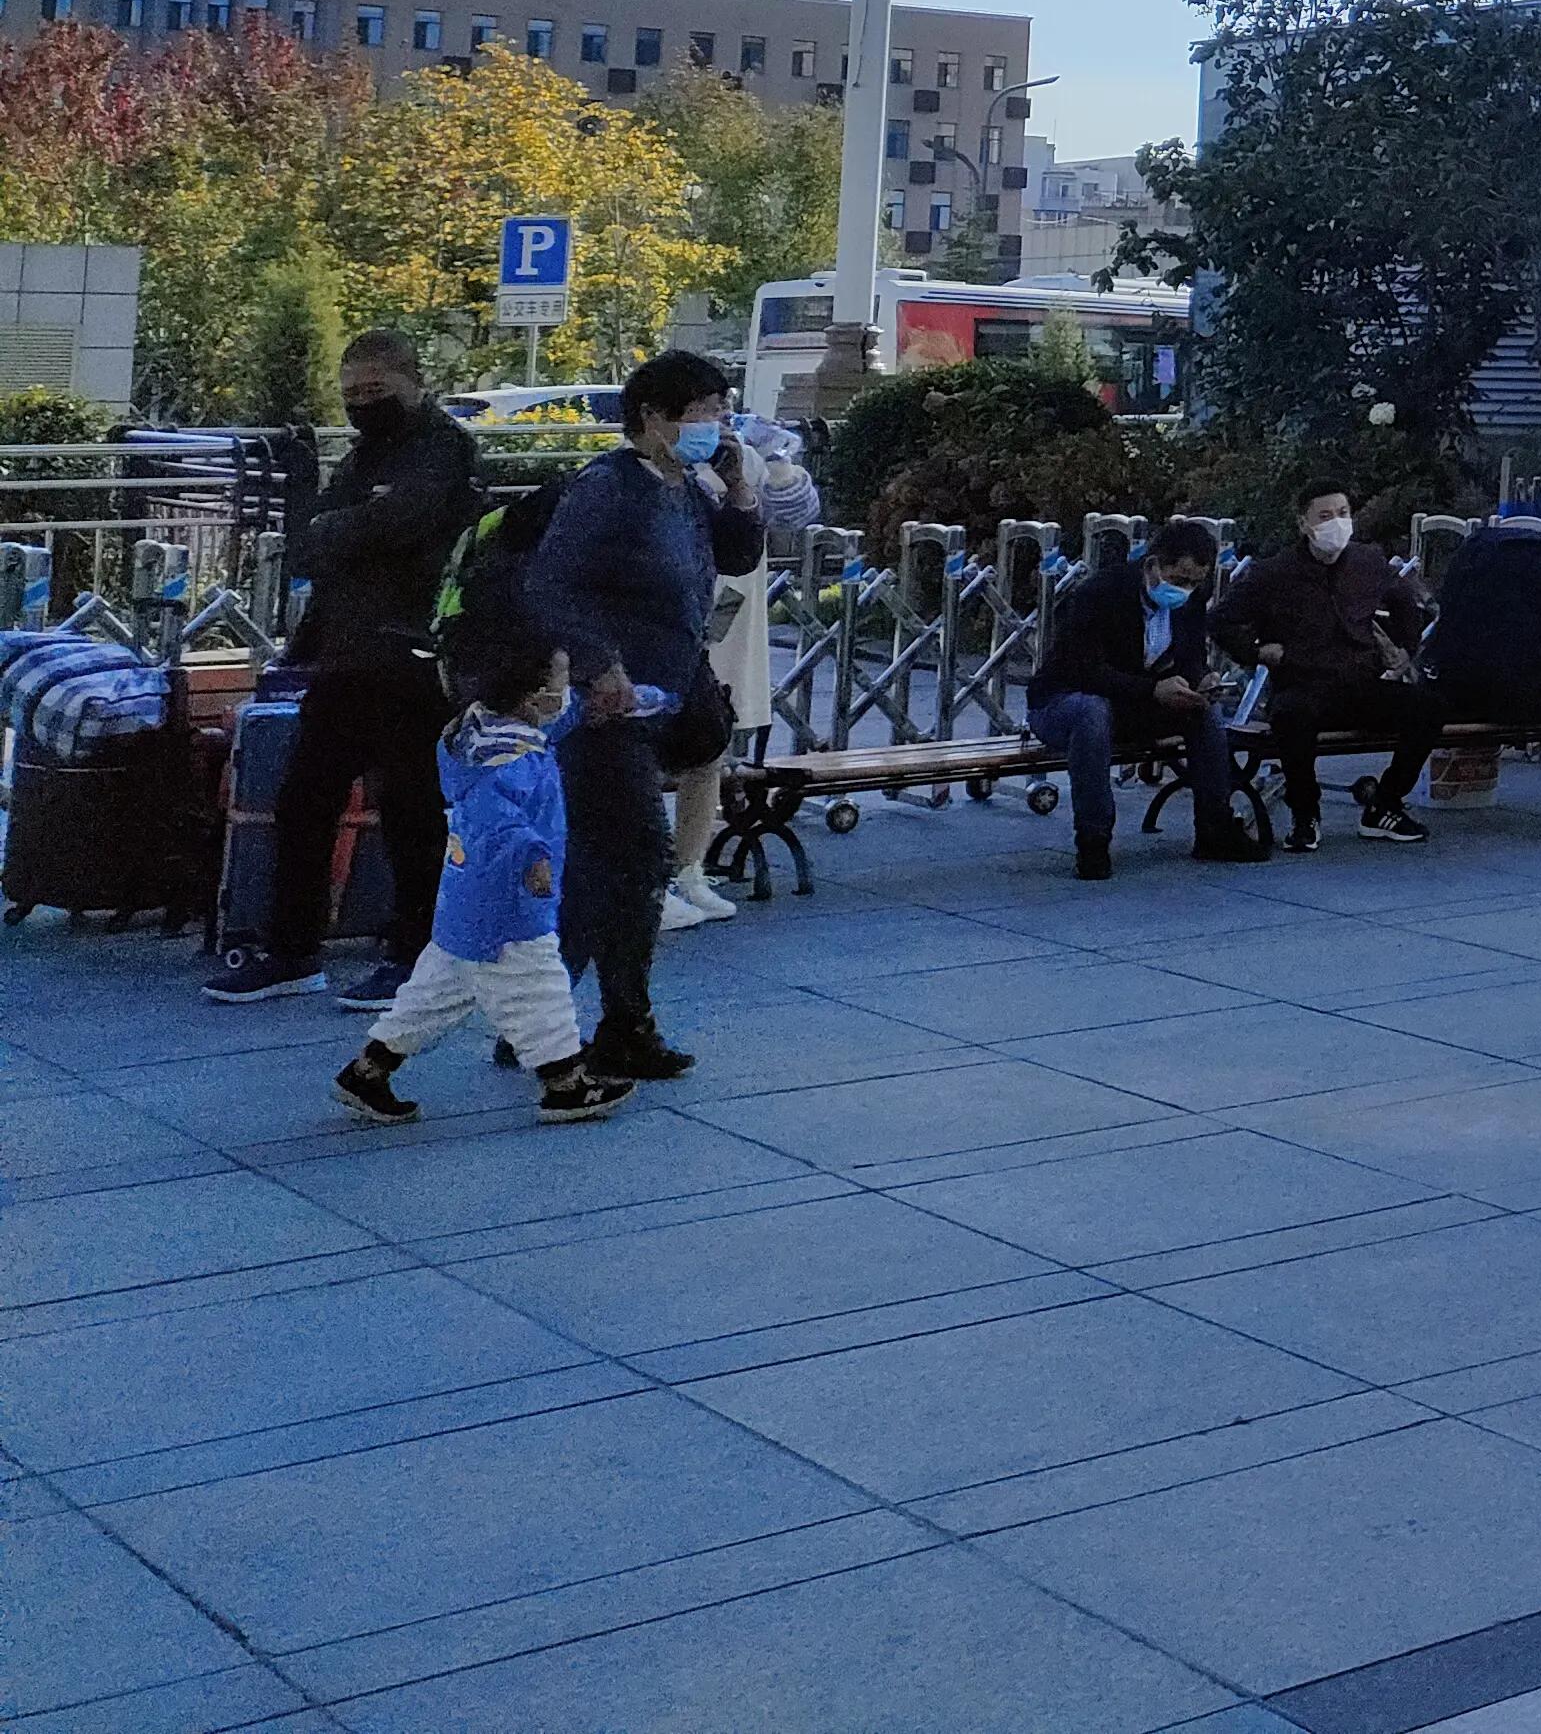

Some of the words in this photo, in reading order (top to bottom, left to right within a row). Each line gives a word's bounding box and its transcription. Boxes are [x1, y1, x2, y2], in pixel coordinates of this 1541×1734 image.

[515, 225, 556, 276] P
[502, 299, 562, 318] 公交车专用
